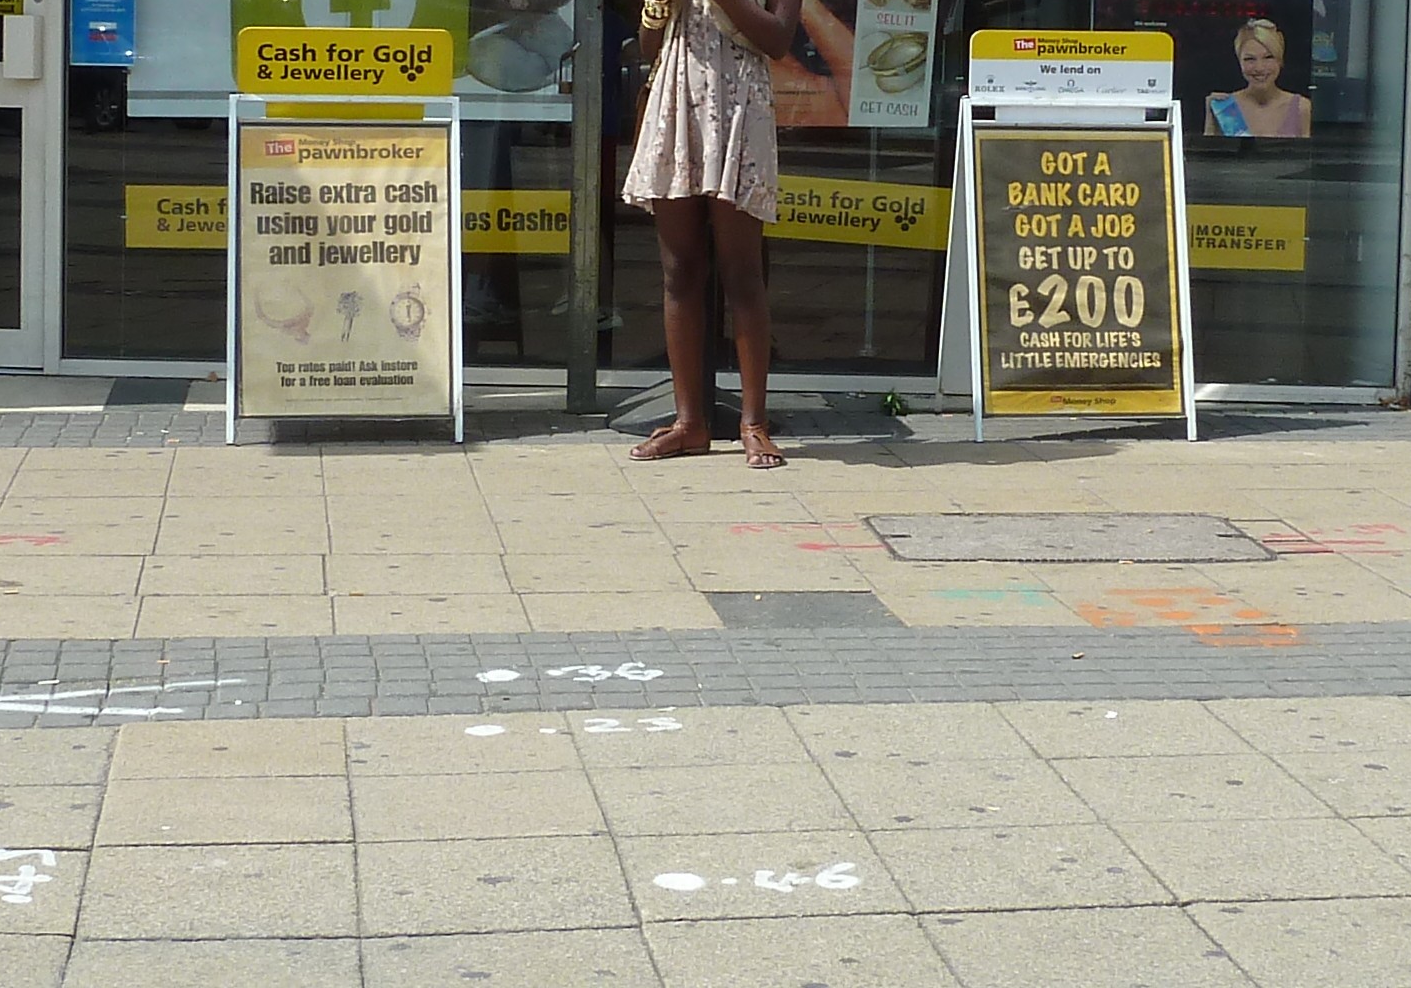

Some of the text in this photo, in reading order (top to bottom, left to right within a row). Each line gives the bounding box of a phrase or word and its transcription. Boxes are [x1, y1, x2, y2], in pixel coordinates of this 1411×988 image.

[876, 13, 917, 26] SELL IT
[257, 42, 433, 67] Cash for Gold
[1015, 40, 1035, 50] The
[1037, 43, 1127, 56] pawnbroker
[257, 64, 385, 85] & Jewellery
[1040, 64, 1102, 75] We lend on
[974, 85, 1006, 93] ROLEX
[860, 101, 919, 117] GET CASH
[265, 142, 293, 155] The
[298, 144, 424, 163] pawnbroker
[1041, 151, 1111, 176] GOT A
[250, 181, 438, 205] Raise extra cash
[1008, 182, 1140, 208] BANK CARD
[157, 197, 209, 216] Cash
[830, 191, 863, 210] for
[872, 196, 925, 218] Gold
[157, 217, 171, 232] &
[257, 212, 318, 237] using
[326, 215, 376, 236] your
[384, 211, 432, 236] gold
[497, 208, 571, 231] Cashe
[787, 208, 881, 232] Jewellery
[1015, 213, 1136, 238] GOT A JOB
[1196, 225, 1258, 238] MONEY
[1196, 237, 1287, 251] TRANSFER
[269, 241, 421, 267] and jewellery
[1018, 246, 1134, 271] GET UP TO
[1009, 275, 1145, 329] £200
[1020, 331, 1141, 348] CASH FOR LIFE'S
[276, 359, 418, 375] Top rates paid! Ask instore
[1001, 351, 1161, 369] LITTLE EMERGENCIES
[280, 373, 414, 388] for a free loan evaluation
